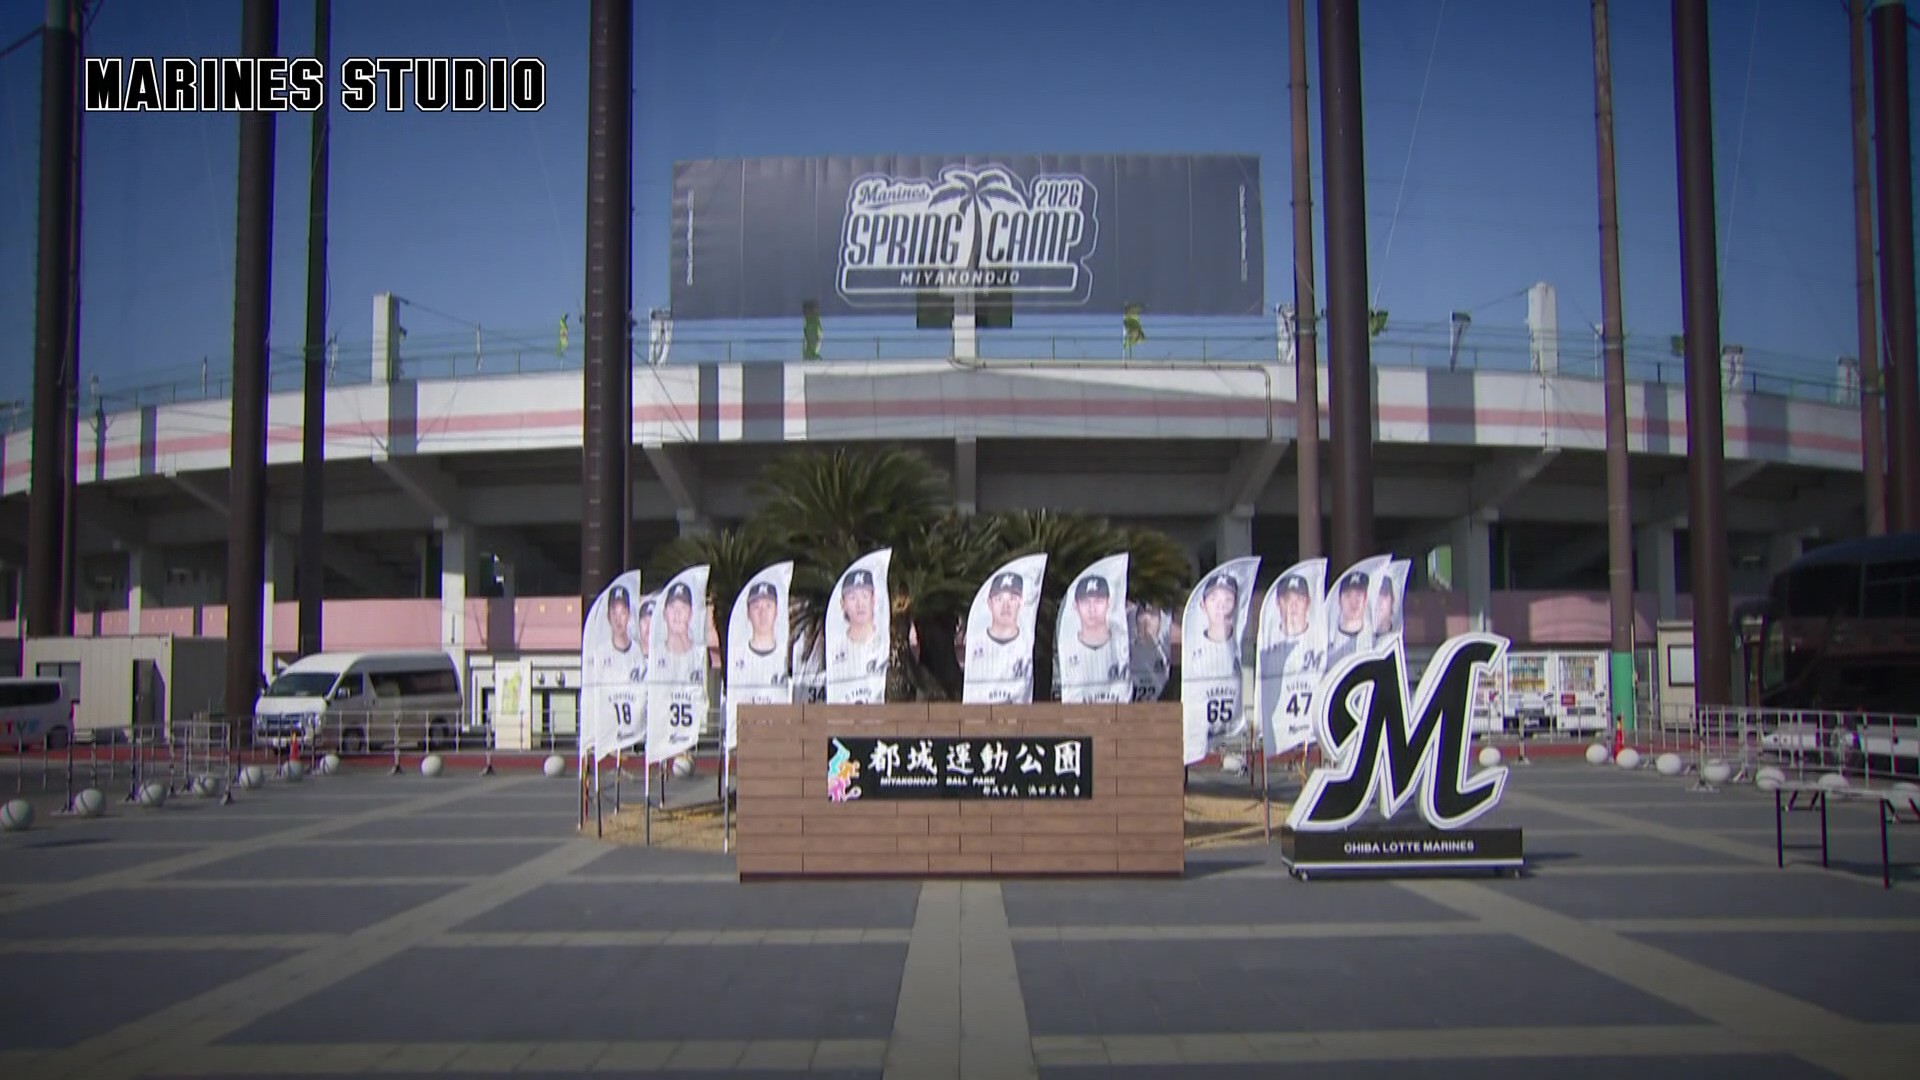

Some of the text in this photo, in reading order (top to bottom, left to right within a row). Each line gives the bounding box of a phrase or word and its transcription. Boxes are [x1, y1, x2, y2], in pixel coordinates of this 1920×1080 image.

[858, 181, 1082, 207] Marines 2026
[847, 210, 1083, 266] SPRING CAMP
[900, 270, 1021, 286] MIYAKONOJO
[614, 702, 632, 725] 18
[669, 703, 693, 727] 35
[1206, 698, 1234, 724] 65
[1286, 692, 1313, 718] 47
[1297, 637, 1505, 826] M
[867, 740, 1083, 778] 都城運動公園
[945, 776, 968, 786] BALL
[972, 776, 996, 786] PARK
[1344, 839, 1475, 854] CHIBA LOTTE MARINES
